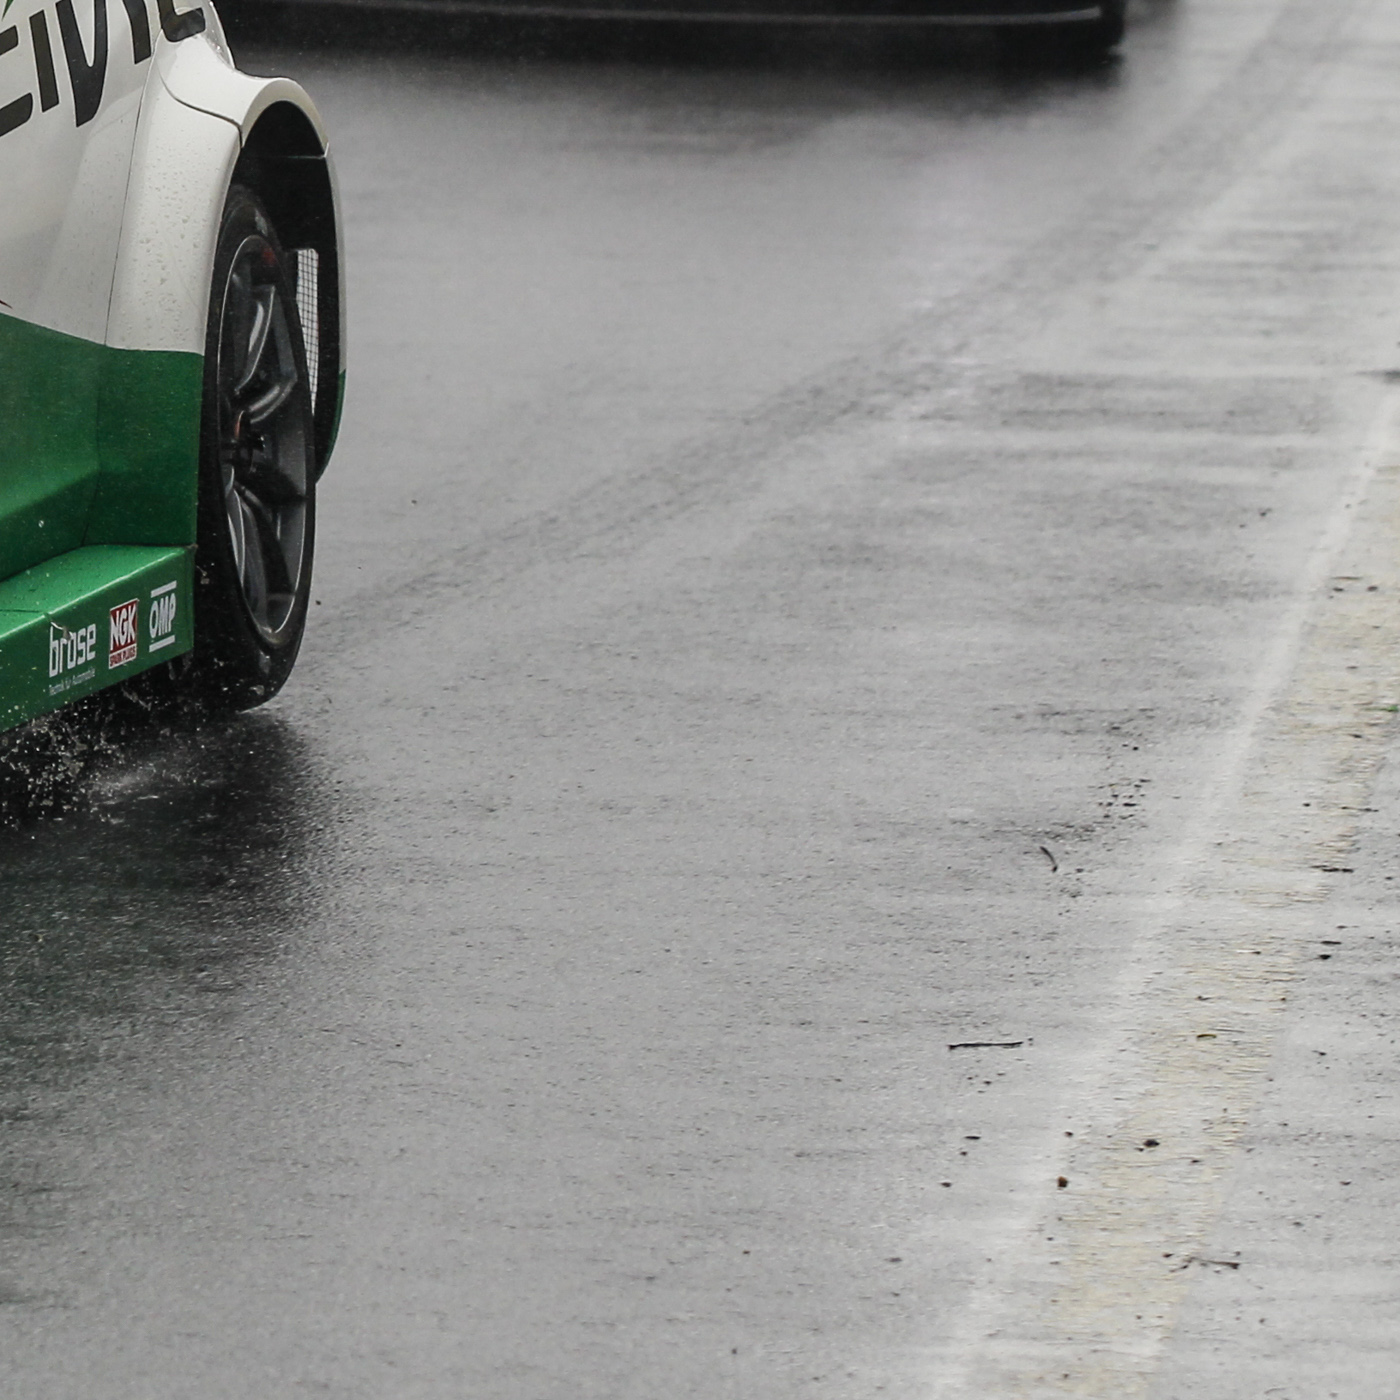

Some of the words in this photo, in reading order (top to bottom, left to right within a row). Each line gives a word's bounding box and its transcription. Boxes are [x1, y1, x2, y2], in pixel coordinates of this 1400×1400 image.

[110, 603, 137, 651] NGK
[149, 593, 176, 639] OMP
[49, 623, 96, 678] brose
